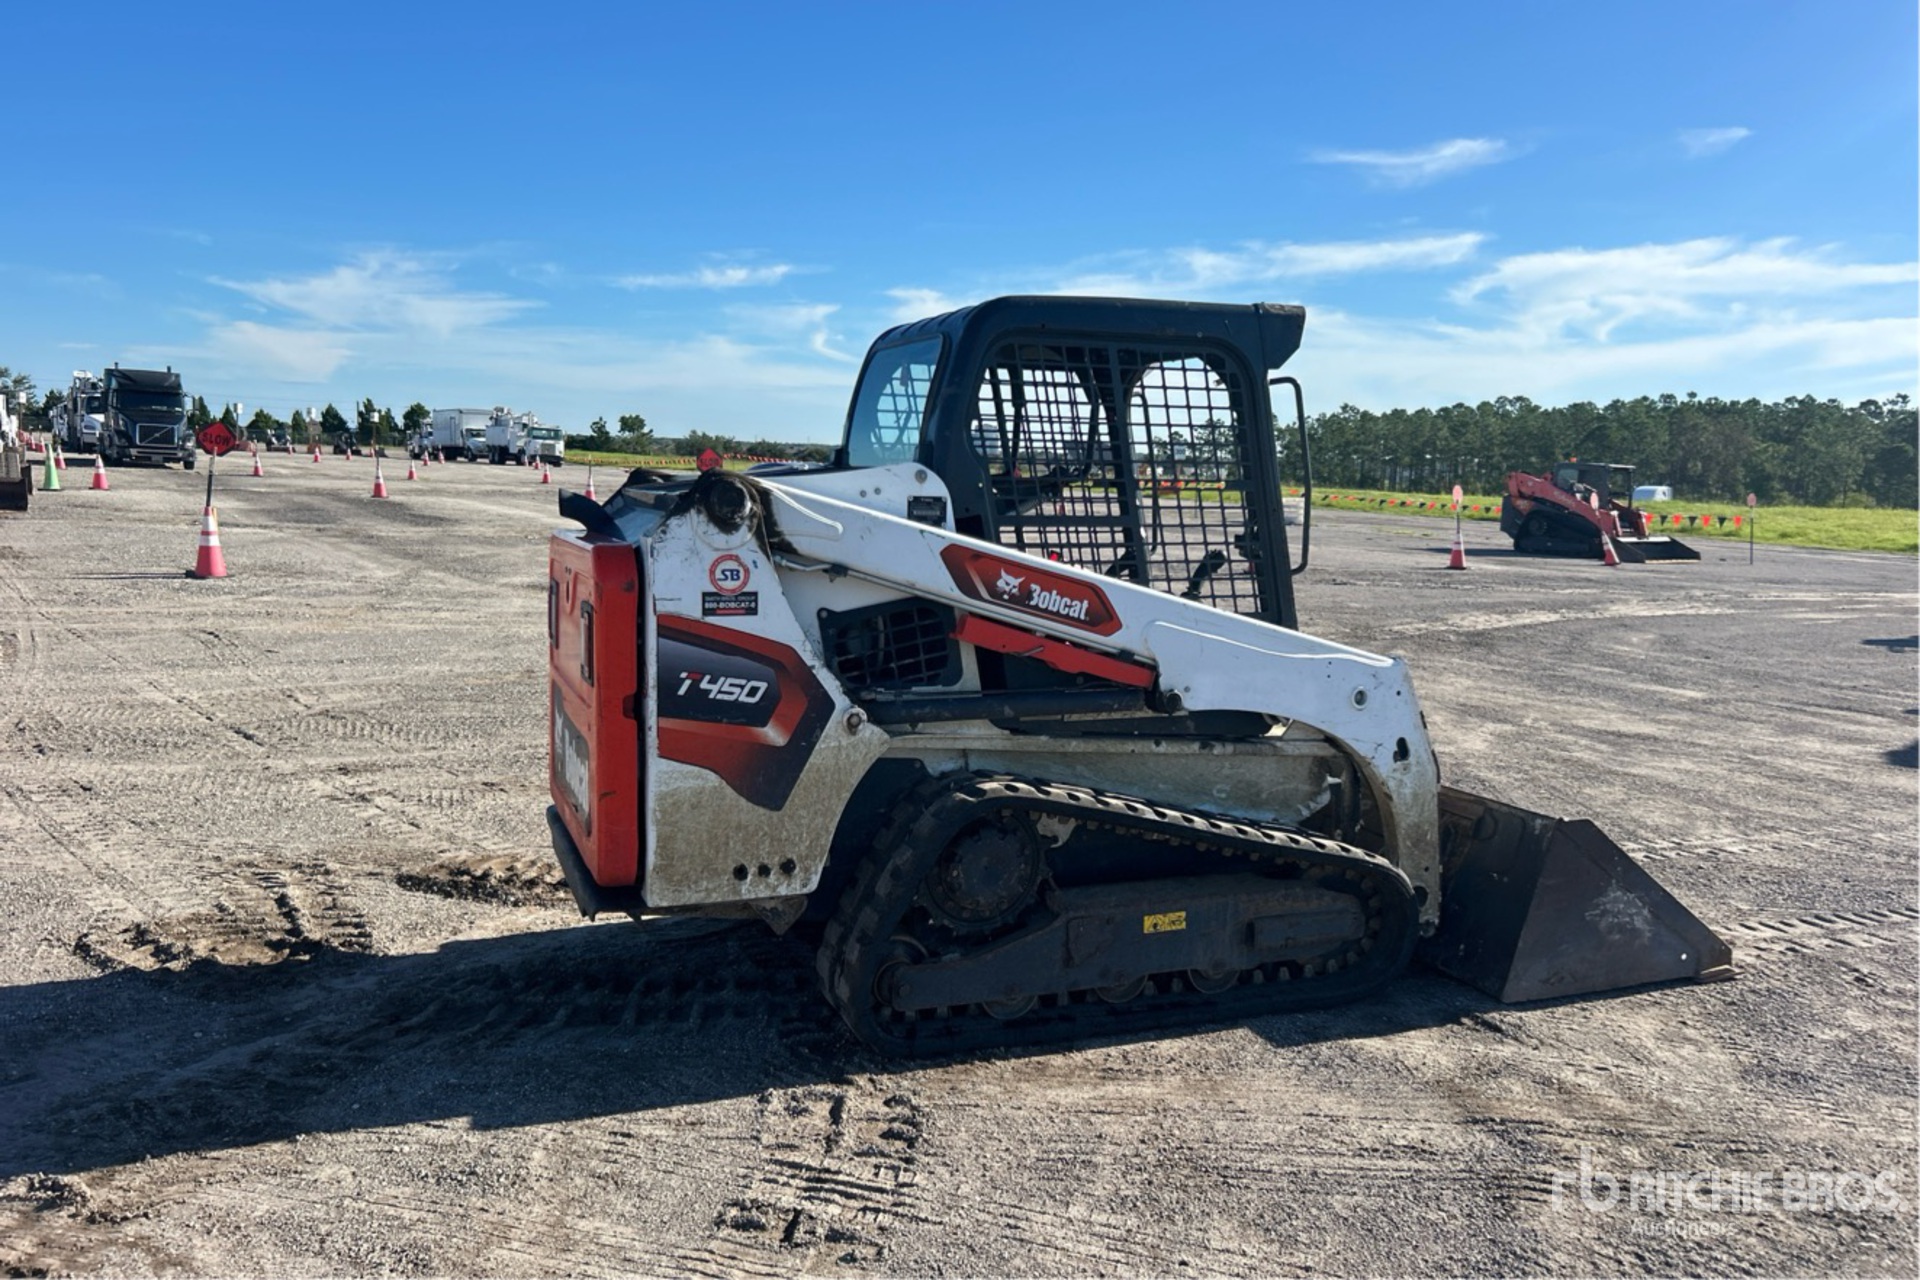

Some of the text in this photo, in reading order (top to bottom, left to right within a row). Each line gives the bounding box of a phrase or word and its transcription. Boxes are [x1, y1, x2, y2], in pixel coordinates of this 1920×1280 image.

[202, 431, 233, 446] SLOW
[717, 568, 741, 581] SB
[1025, 583, 1089, 620] Bobcat
